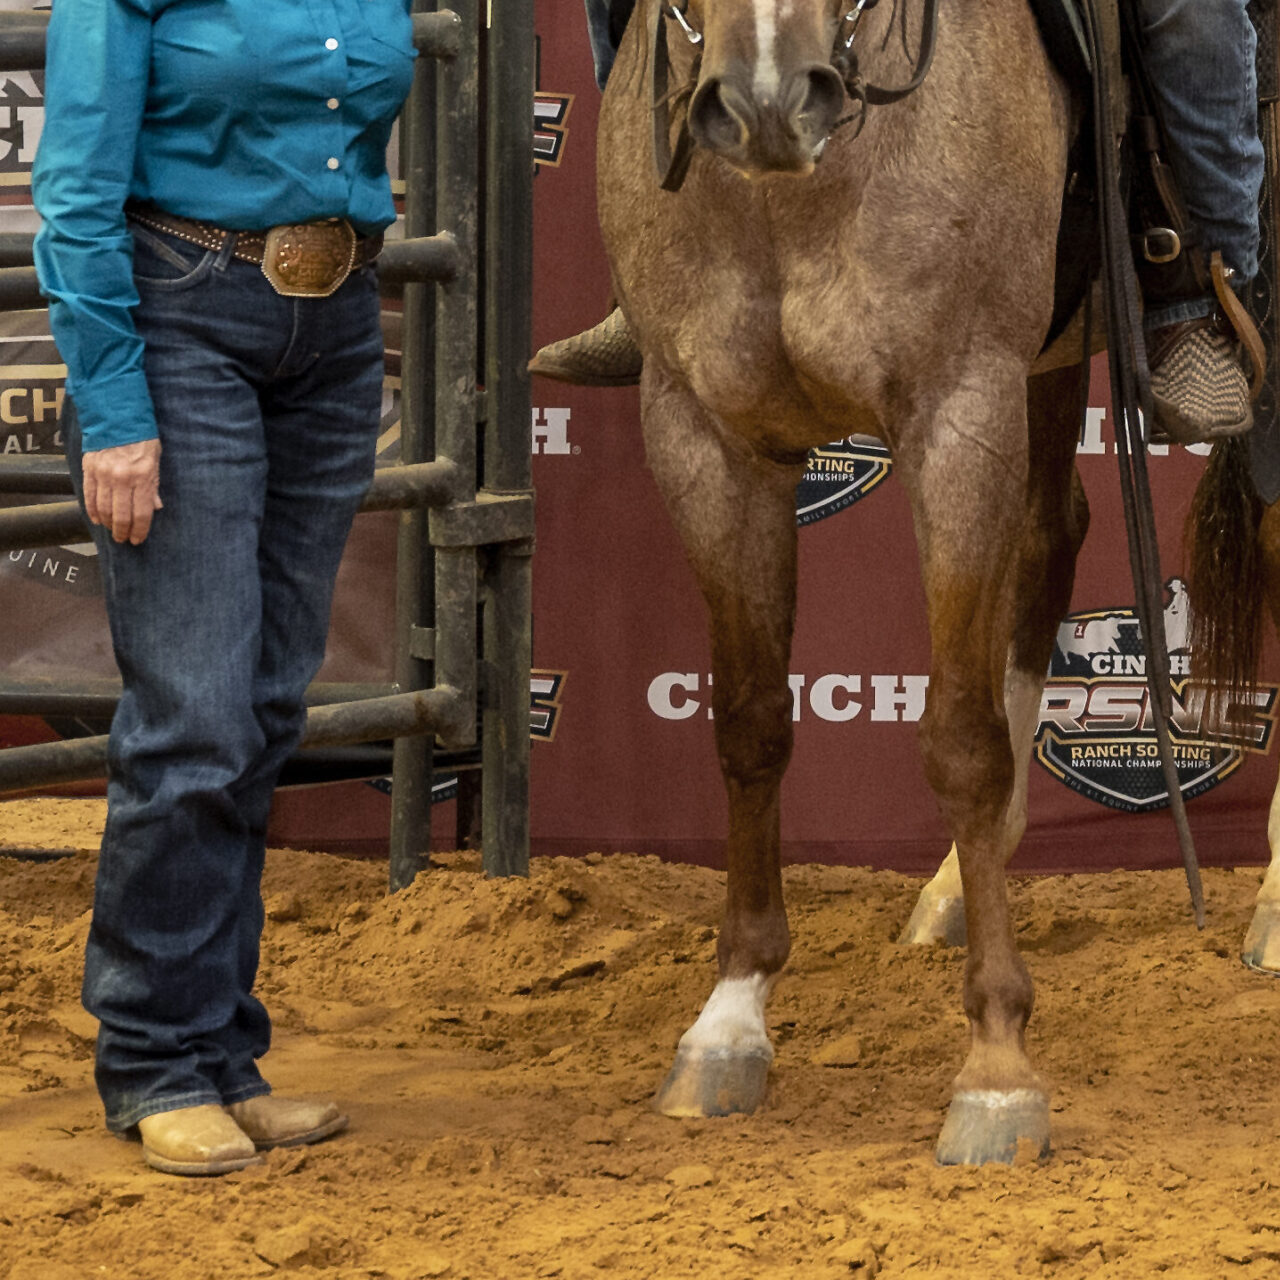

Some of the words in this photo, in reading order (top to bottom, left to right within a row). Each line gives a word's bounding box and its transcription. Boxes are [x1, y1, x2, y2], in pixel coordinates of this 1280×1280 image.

[806, 458, 855, 473] RTING
[1091, 654, 1191, 675] CINH
[647, 672, 930, 722] CCH
[1071, 745, 1132, 759] RANCH
[1136, 745, 1211, 760] SOTING
[1071, 759, 1123, 768] NATIONAL
